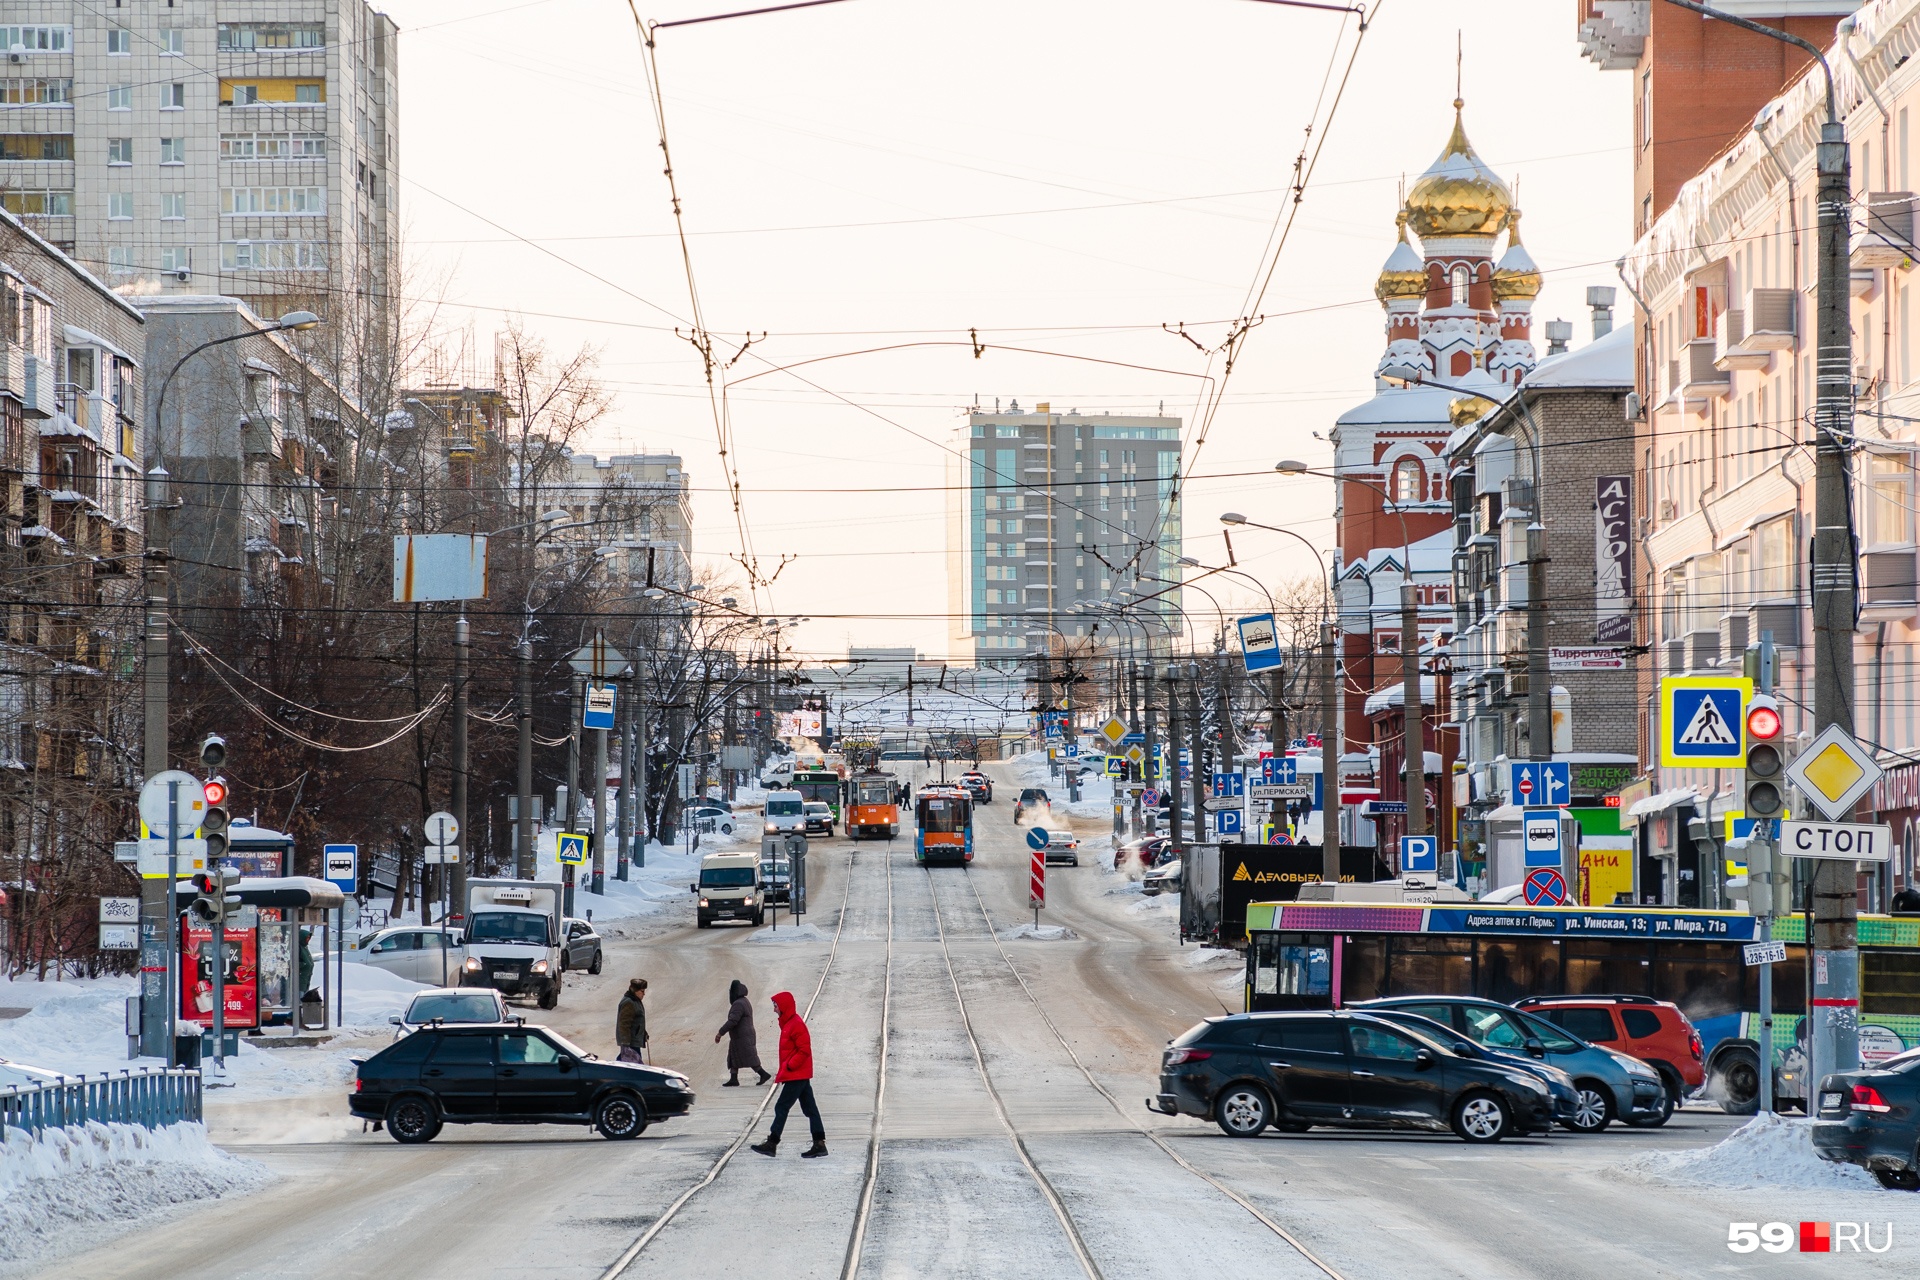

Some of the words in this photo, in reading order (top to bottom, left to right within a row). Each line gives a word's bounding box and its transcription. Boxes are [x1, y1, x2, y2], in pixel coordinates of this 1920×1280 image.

[1600, 480, 1627, 599] АССОЛЬ
[1600, 617, 1621, 631] САЛОН
[1600, 623, 1630, 641] КРАСОТЫ
[1551, 648, 1622, 659] Tupperware
[1580, 767, 1631, 778] АПТЕКА
[1577, 778, 1634, 789] РОМА
[1253, 787, 1306, 796] ул.ПЕРМСКАЯ
[1795, 828, 1874, 853] СТОП
[1467, 915, 1494, 927] Адреса
[1495, 917, 1515, 926] аптек
[1529, 916, 1555, 928] Пермь:
[1565, 918, 1581, 930] ул.
[1584, 917, 1628, 931] Уинская,
[1631, 918, 1647, 931] 13;
[1655, 920, 1671, 932] ул.
[1674, 919, 1705, 933] Мира,
[1708, 920, 1727, 932] 71а
